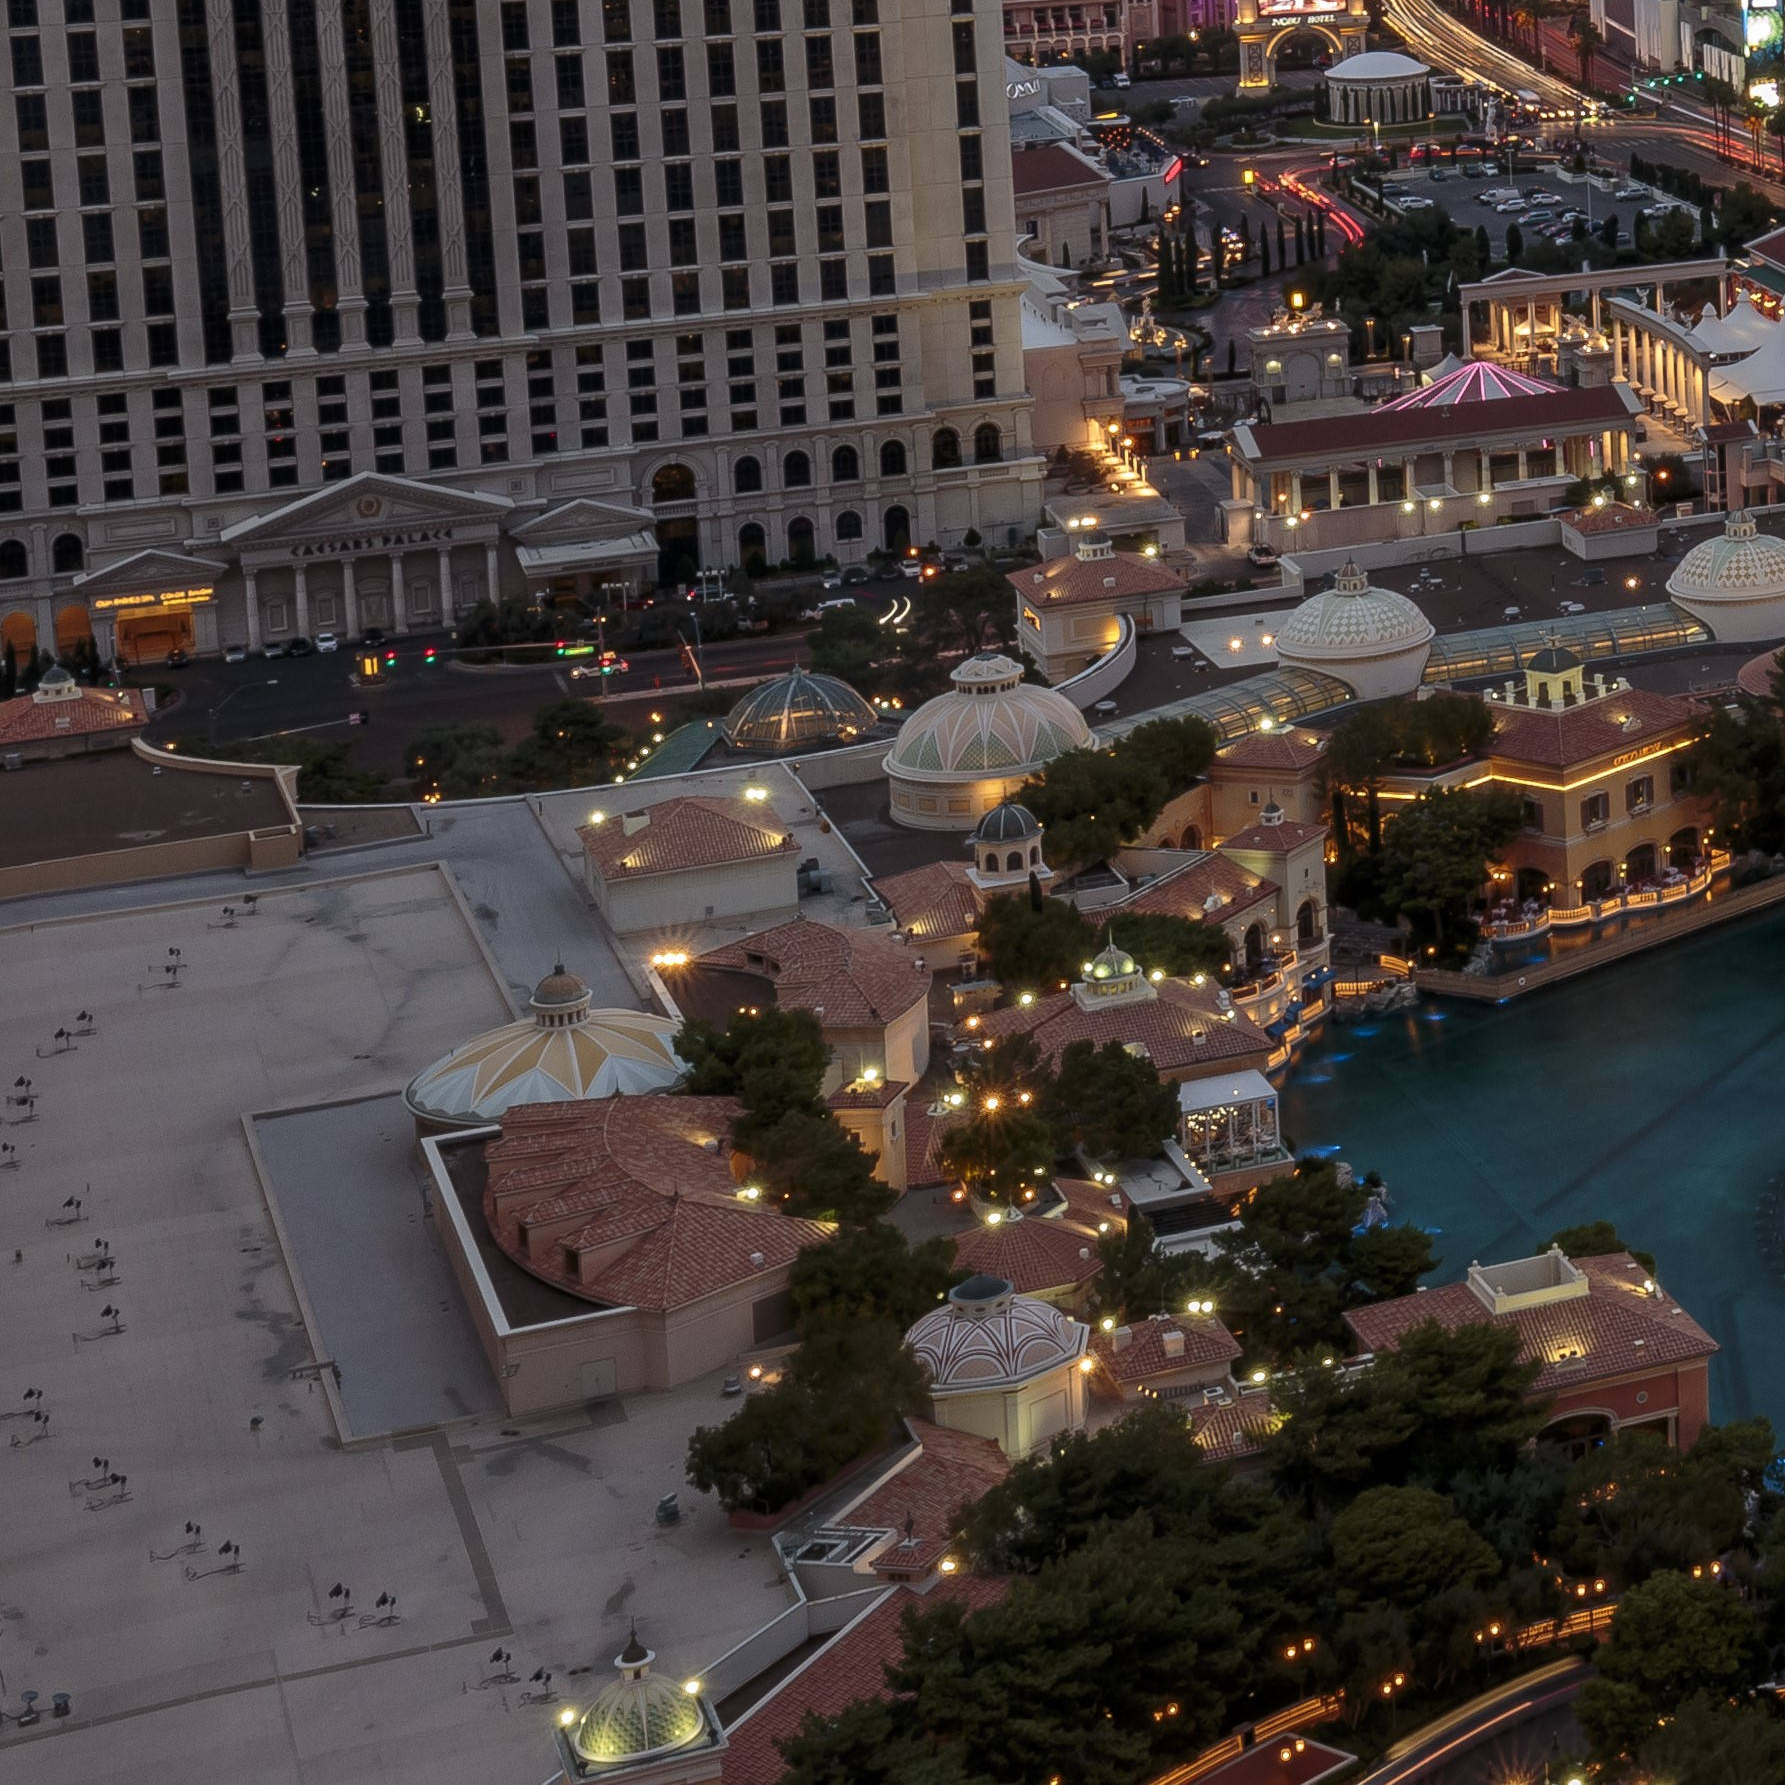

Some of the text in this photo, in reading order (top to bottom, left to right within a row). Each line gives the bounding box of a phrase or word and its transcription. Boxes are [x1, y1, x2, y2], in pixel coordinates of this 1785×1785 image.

[1272, 14, 1336, 26] NOBU HOTEL
[290, 529, 453, 556] CAESARS PALACE
